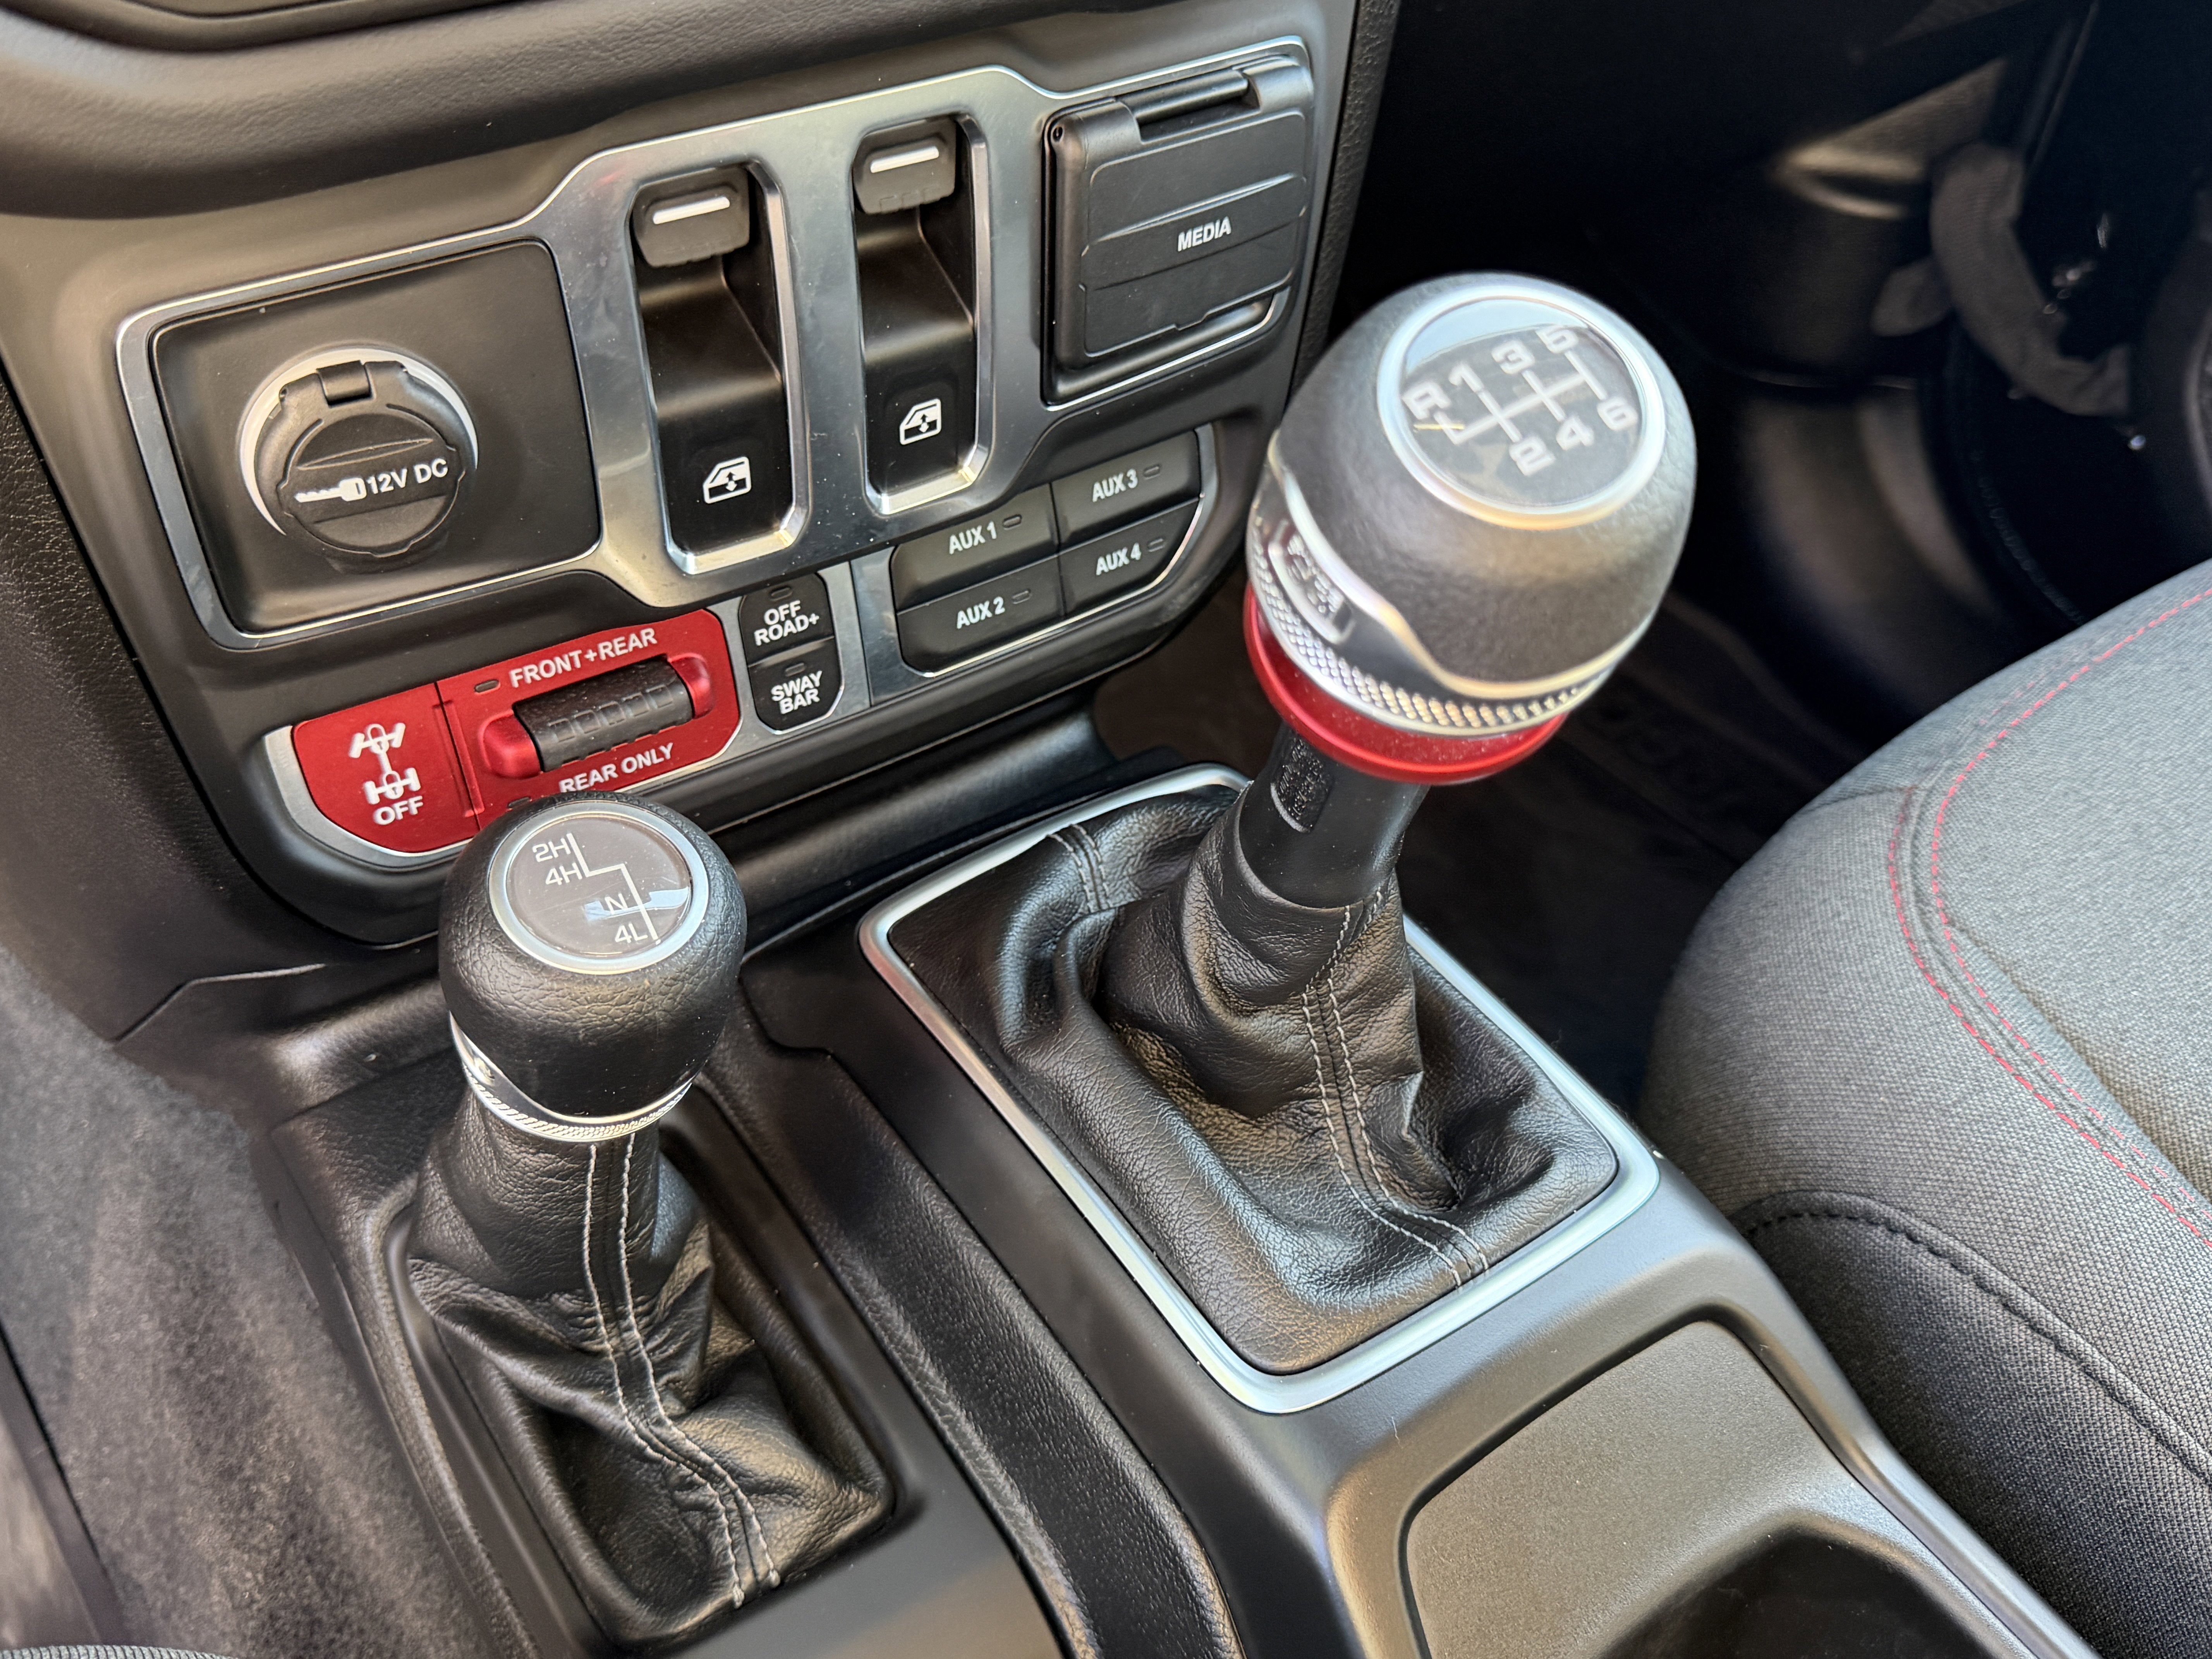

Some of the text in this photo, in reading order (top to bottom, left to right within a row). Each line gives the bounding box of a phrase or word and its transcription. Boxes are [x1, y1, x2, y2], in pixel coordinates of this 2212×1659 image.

[1178, 216, 1231, 252] MEDIA
[1402, 325, 1579, 420] R 1 3 5
[1509, 395, 1638, 476] 2 4 6
[366, 458, 448, 495] 12V DC
[1092, 468, 1138, 502] AUX 3
[949, 520, 997, 554] AUX 1
[1096, 543, 1142, 575] AUX 4
[764, 600, 801, 625] OFF
[956, 596, 1005, 629] AUX 2
[754, 613, 820, 646] ROAD+
[509, 627, 658, 688] FRONT+REAR
[771, 670, 823, 702] SWAY
[779, 689, 820, 714] BAR
[559, 742, 674, 793] REAR ONLY
[373, 795, 424, 825] OFF
[532, 838, 572, 862] 2H
[545, 862, 583, 886] 4H
[605, 893, 628, 915] N
[614, 923, 648, 943] 4L
